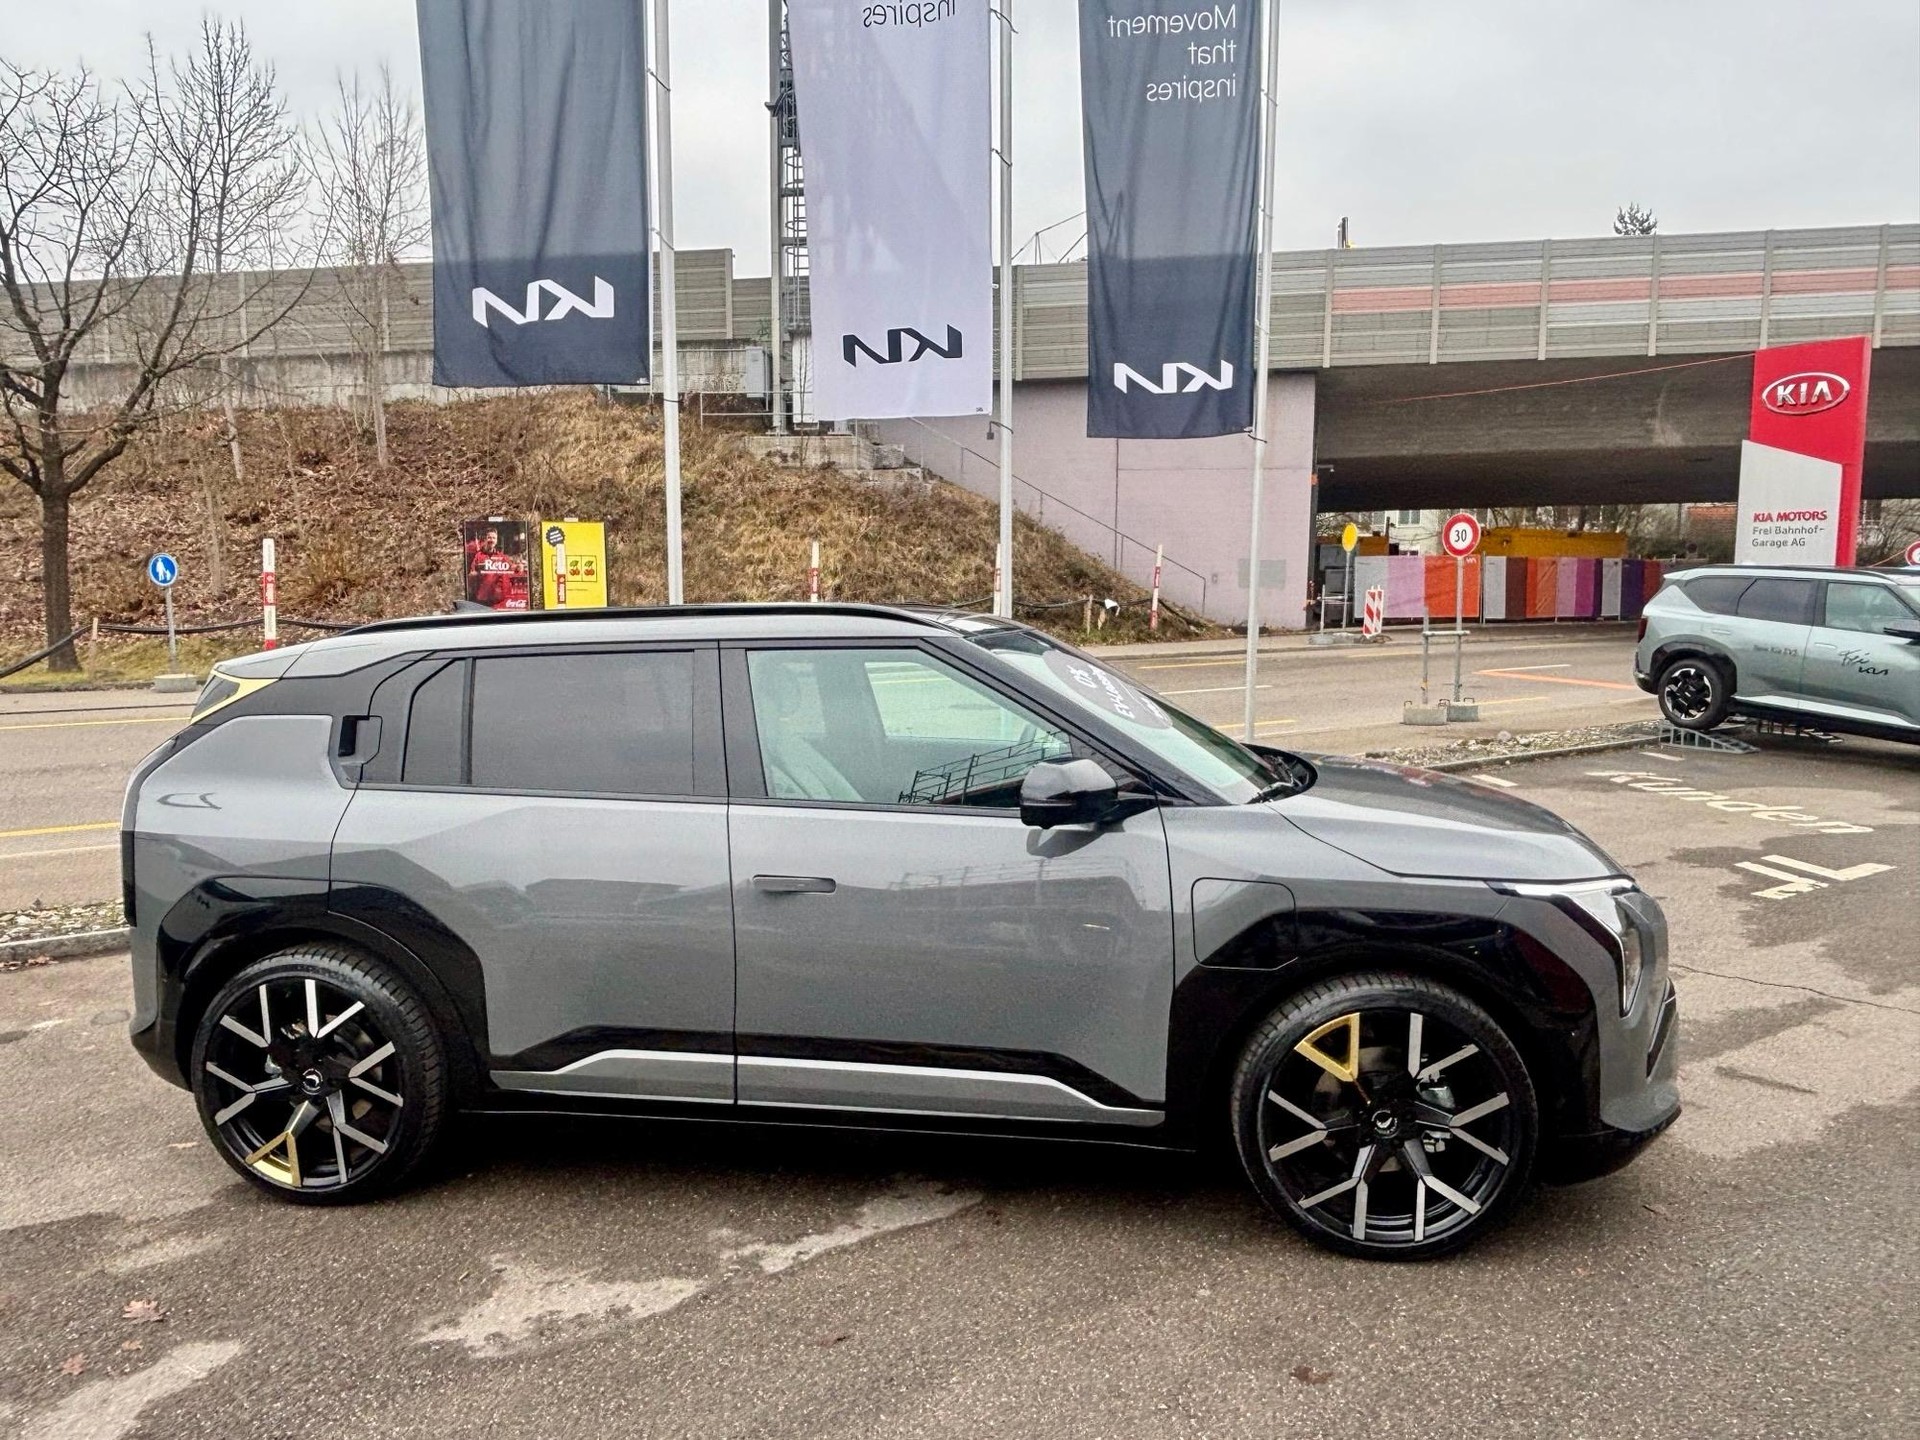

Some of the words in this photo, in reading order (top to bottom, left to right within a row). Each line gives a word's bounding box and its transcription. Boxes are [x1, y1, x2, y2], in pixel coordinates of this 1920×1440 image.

[1776, 380, 1833, 407] KIA
[1753, 512, 1774, 523] KIA
[1776, 510, 1828, 522] MOTORS
[1454, 529, 1468, 543] 30
[1751, 538, 1788, 548] Garage
[1790, 538, 1806, 547] AG
[1585, 771, 1874, 834] Kunden
